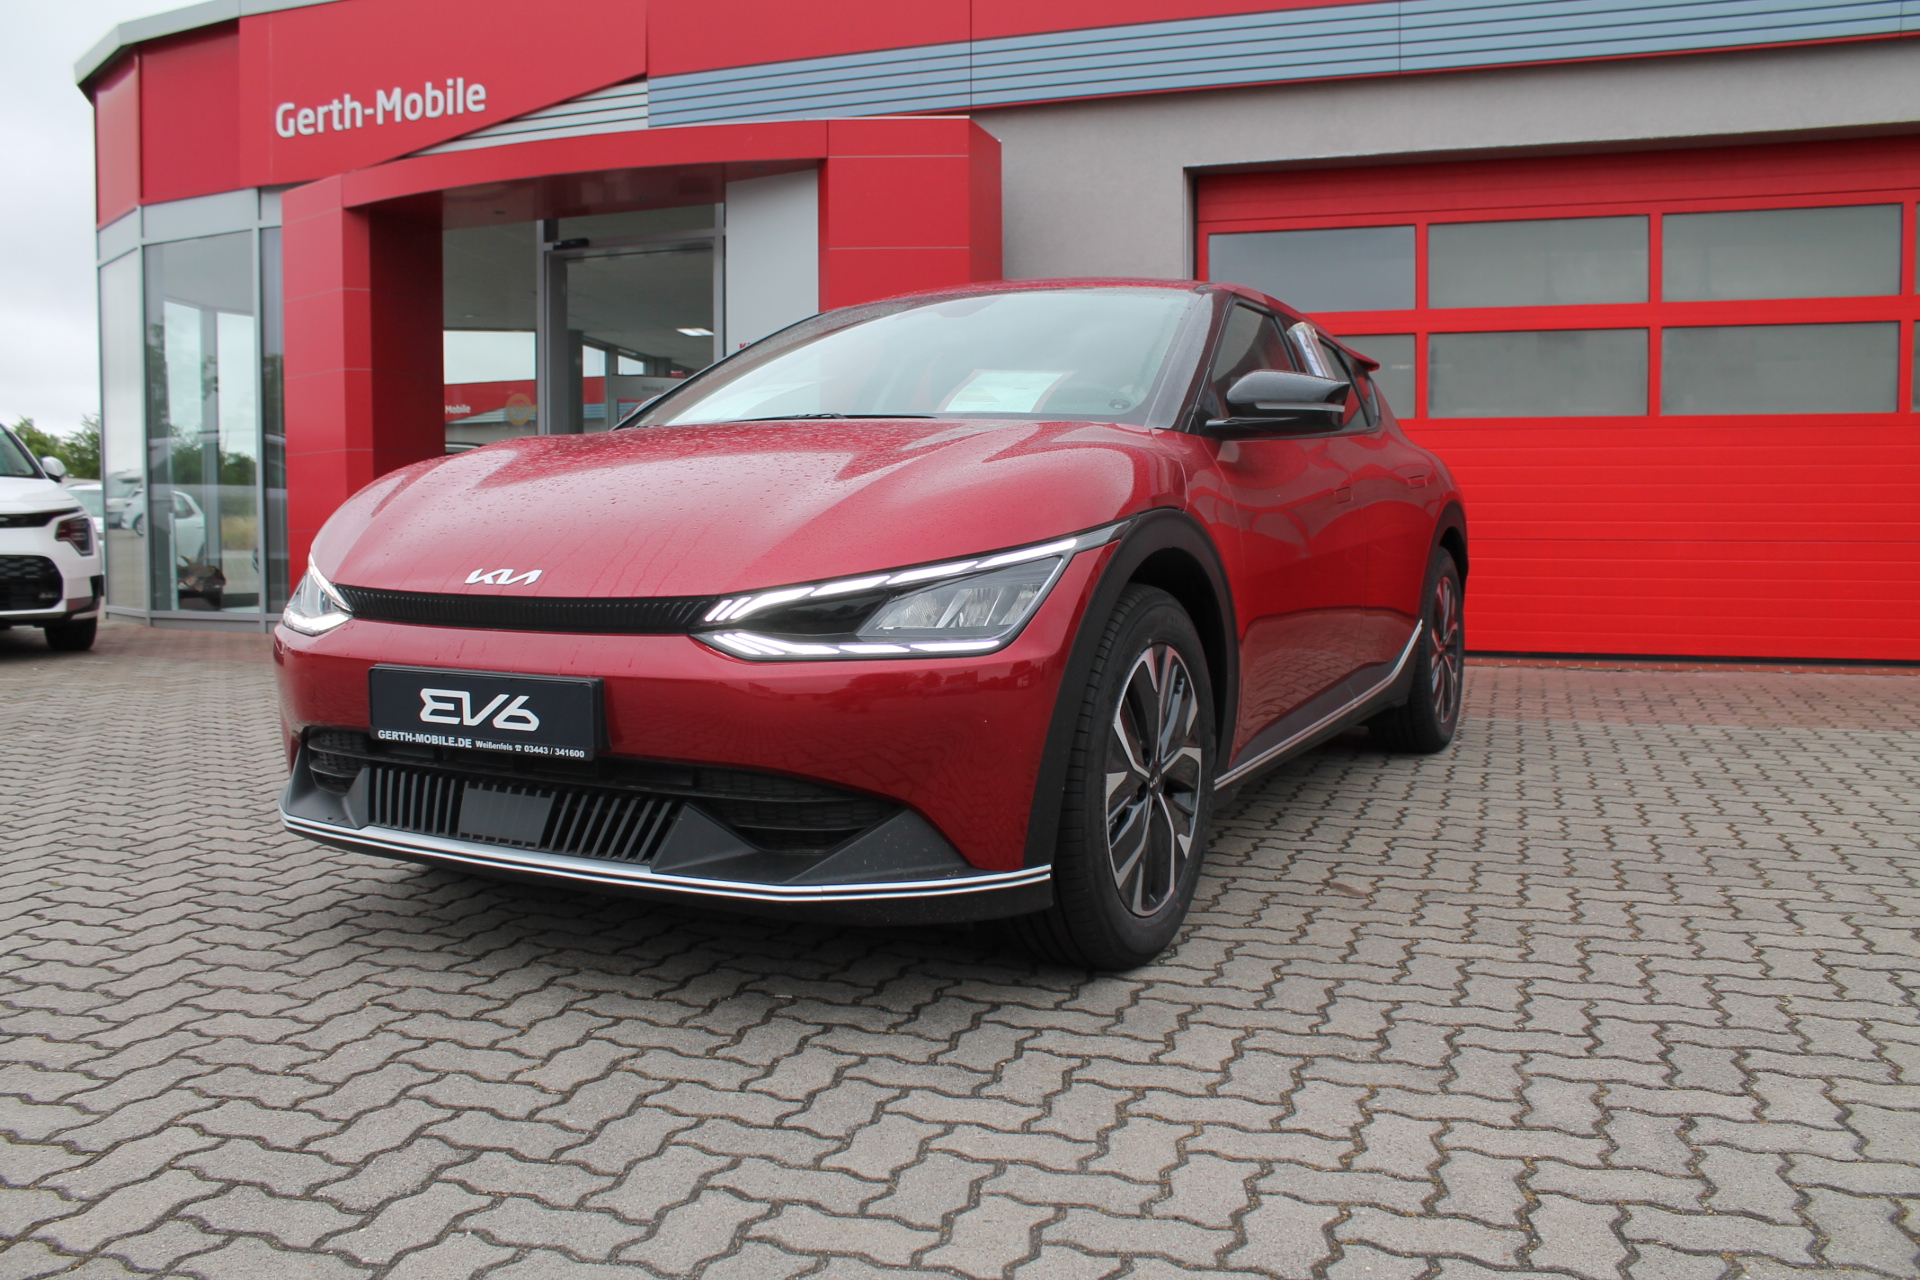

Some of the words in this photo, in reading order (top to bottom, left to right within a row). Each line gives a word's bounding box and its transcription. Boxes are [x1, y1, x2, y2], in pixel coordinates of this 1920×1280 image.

[275, 77, 487, 138] Gerth-Mobile
[444, 404, 472, 415] Mobile
[464, 568, 543, 586] KIA
[419, 687, 540, 732] EV6
[377, 729, 473, 749] GERTH-MOBILE.DE
[475, 740, 513, 752] Weißenfels
[524, 745, 549, 755] 03443
[554, 747, 585, 758] 341600
